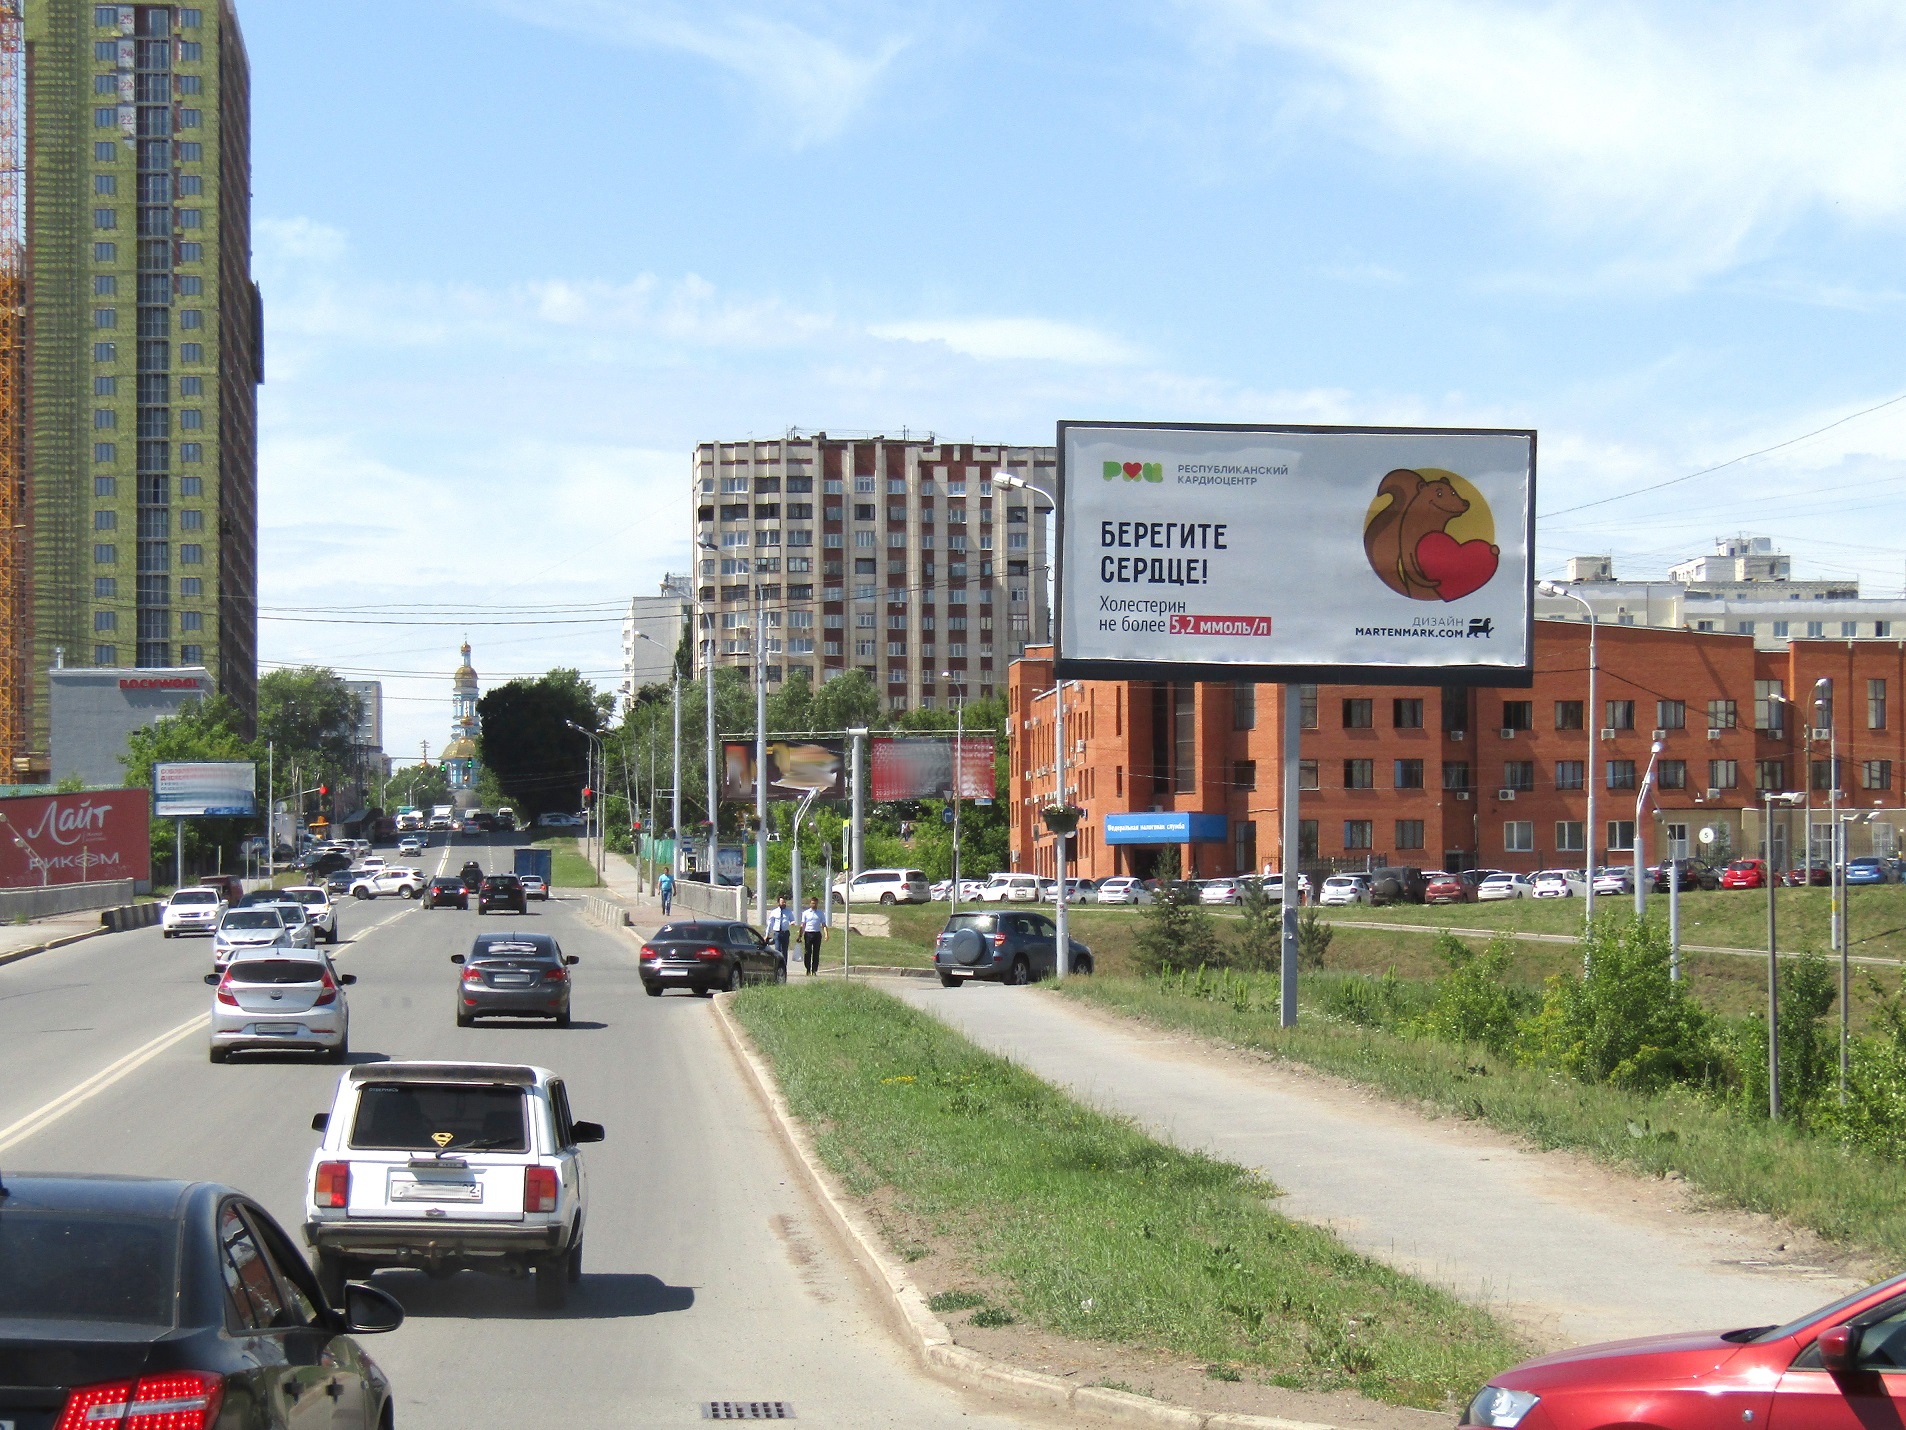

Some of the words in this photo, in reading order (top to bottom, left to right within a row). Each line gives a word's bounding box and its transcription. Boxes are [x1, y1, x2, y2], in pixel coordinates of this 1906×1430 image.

[1177, 464, 1289, 475] РЕСПУБЛИКАНСКИЙ
[1177, 475, 1258, 486] КАРДИОЦЕНТР
[1101, 521, 1228, 549] БЕРЕГИТЕ
[1101, 555, 1208, 586] СЕРДЦЕ!
[1099, 595, 1186, 616] Холестерин
[1099, 618, 1117, 631] не
[1121, 615, 1166, 632] более
[1171, 616, 1195, 635] 5,2
[1200, 619, 1268, 636] ммоль/л
[1412, 616, 1464, 627] ДИЗАЙН
[1355, 627, 1464, 638] MARTENMARK.COM
[27, 799, 112, 846] Лайт
